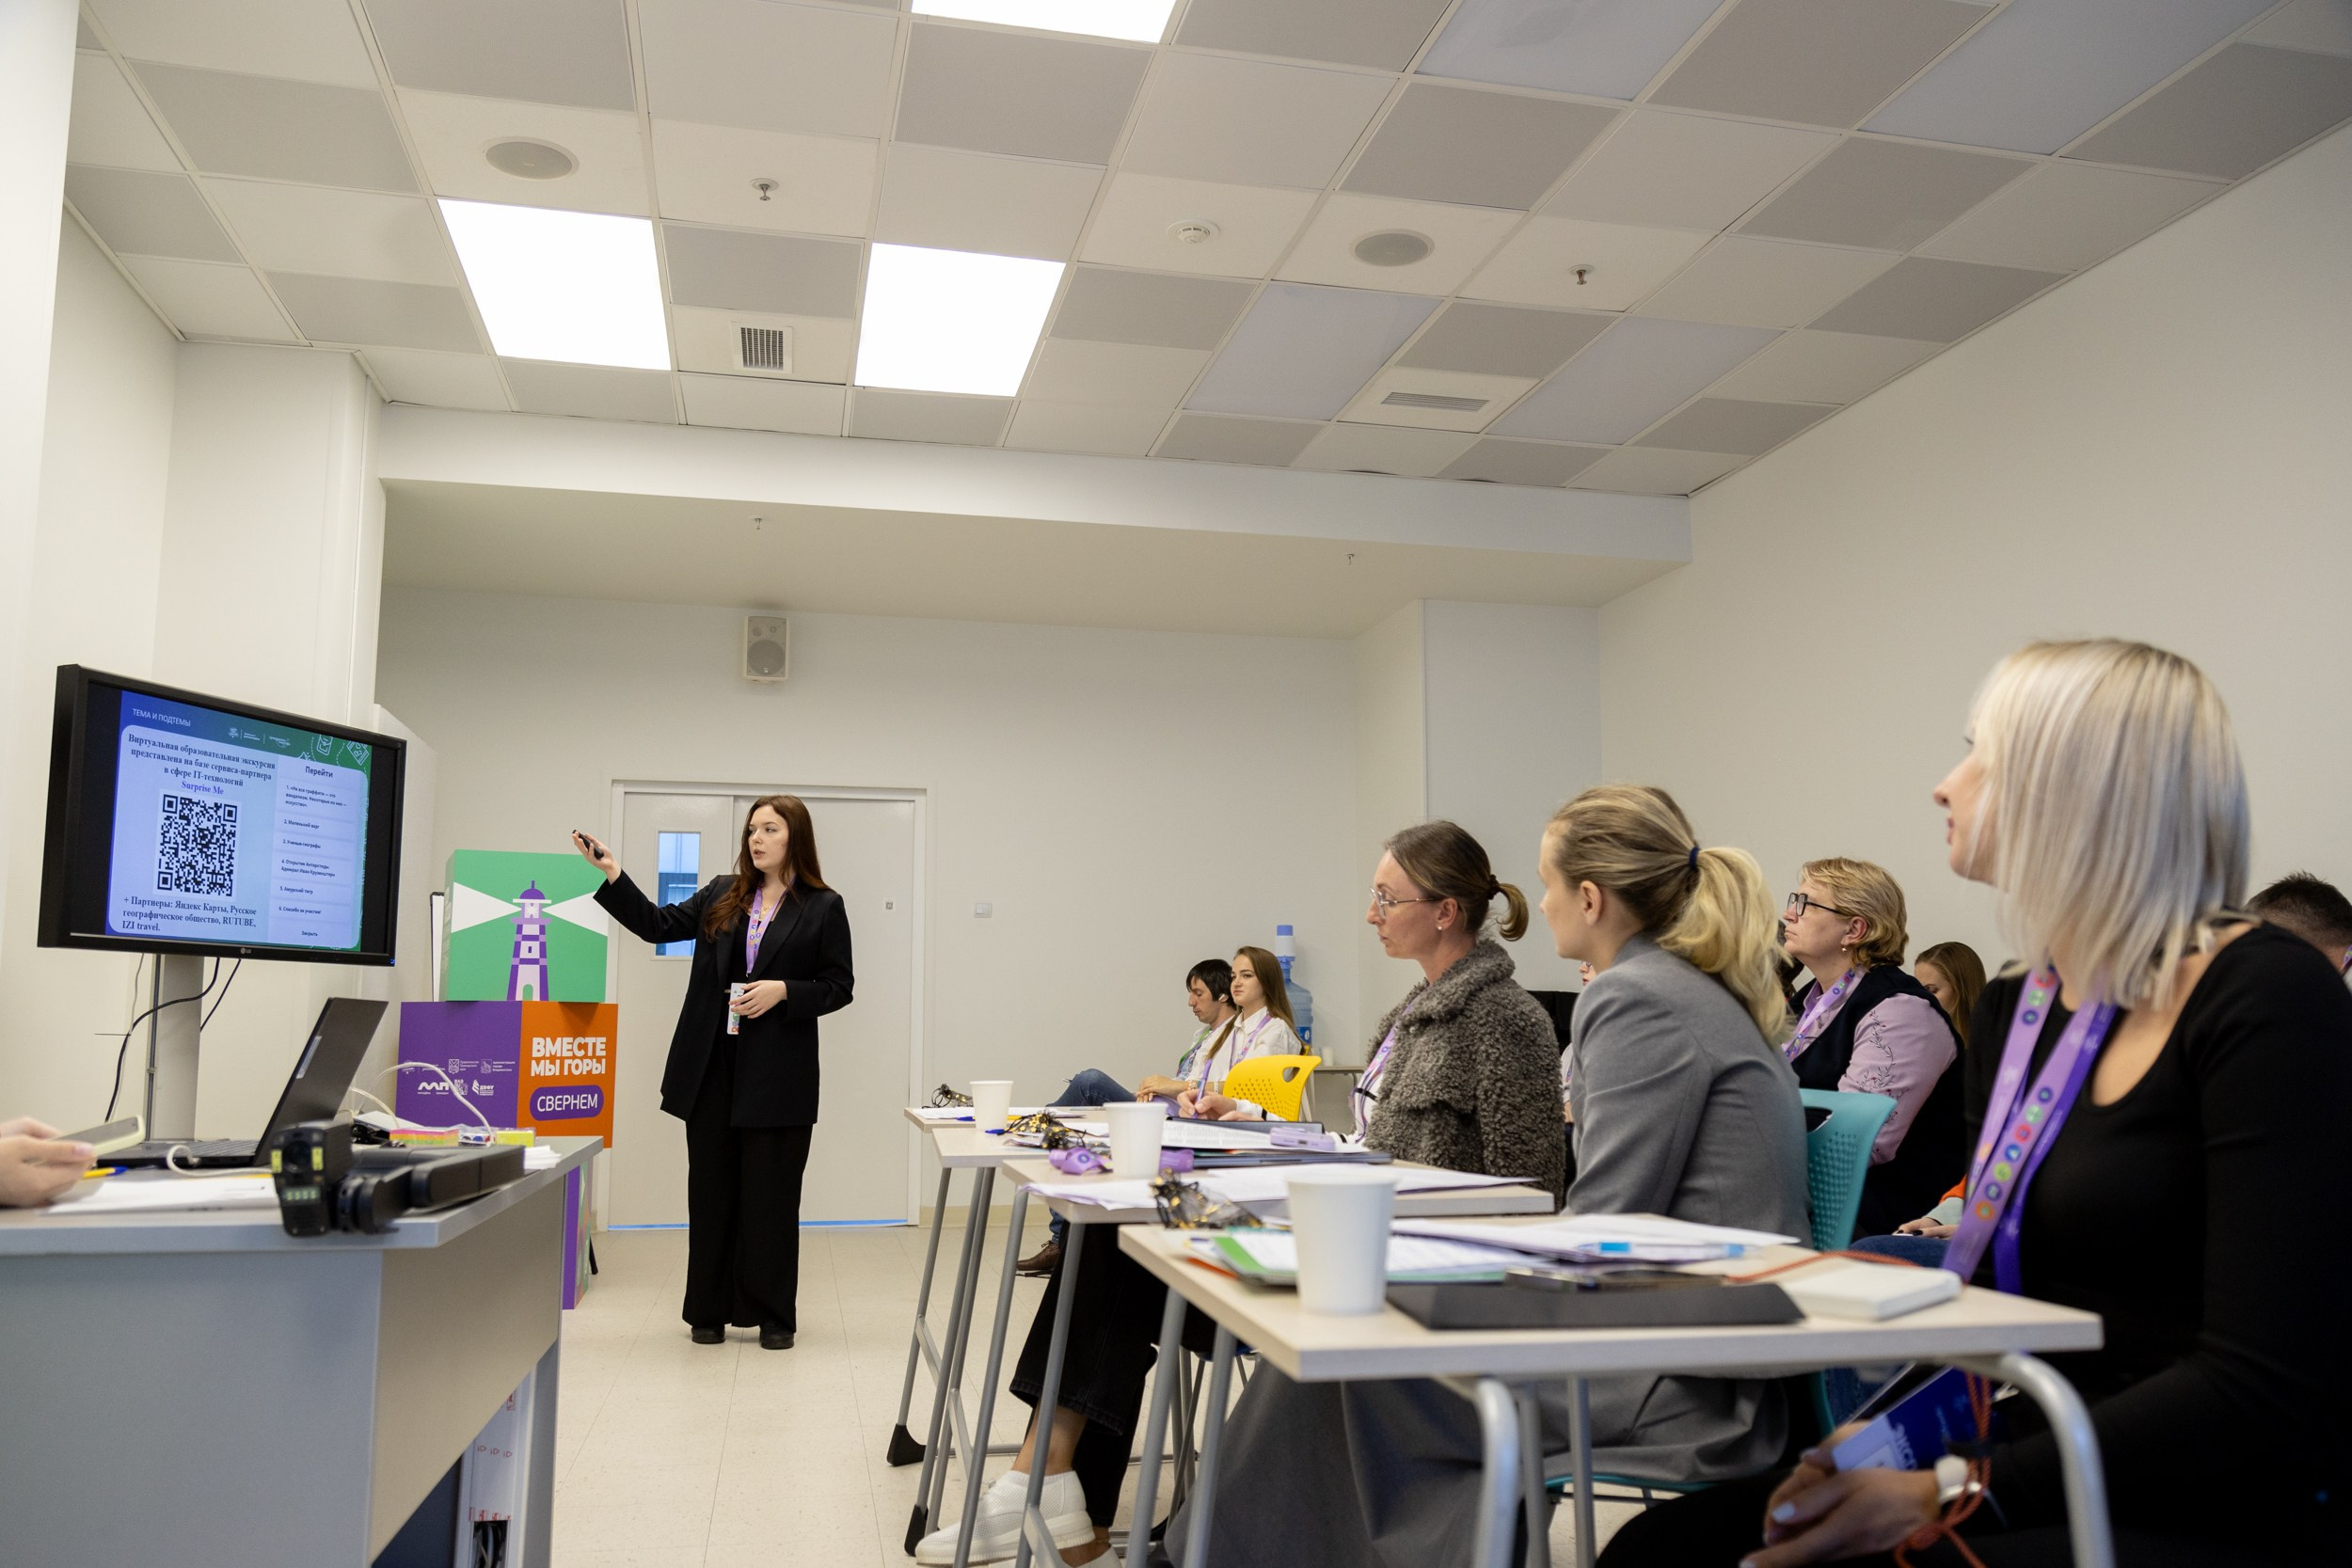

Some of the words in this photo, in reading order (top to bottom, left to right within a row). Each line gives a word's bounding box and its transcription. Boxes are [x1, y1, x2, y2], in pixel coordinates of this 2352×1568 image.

[133, 708, 151, 719] ТЕМА
[158, 715, 191, 727] ПОДТЕМЫ
[128, 734, 178, 752] Виртуальная
[180, 745, 240, 763] образовательная
[241, 757, 276, 770] экскурсия
[131, 748, 183, 764] представлена
[195, 758, 209, 768] базе
[211, 763, 272, 781] сервиса-партнера
[170, 768, 192, 779] сфере
[305, 766, 333, 778] Перейти
[182, 781, 211, 793] Surprise
[213, 786, 224, 795] Me
[131, 896, 173, 909] Партнеры:
[175, 901, 201, 911] Яндекс
[203, 903, 229, 914] Карты,
[230, 906, 257, 916] Русское
[122, 921, 135, 929] IZI
[136, 923, 161, 931] travel.
[123, 911, 183, 922] географическое
[184, 914, 221, 926] общество,
[222, 916, 257, 927] RUTUBE,
[532, 1037, 606, 1057] ВМЕСТЕ
[531, 1059, 561, 1076] МЫ
[564, 1058, 606, 1076] ГОРЫ
[536, 1093, 598, 1112] СВЕРНЕМ
